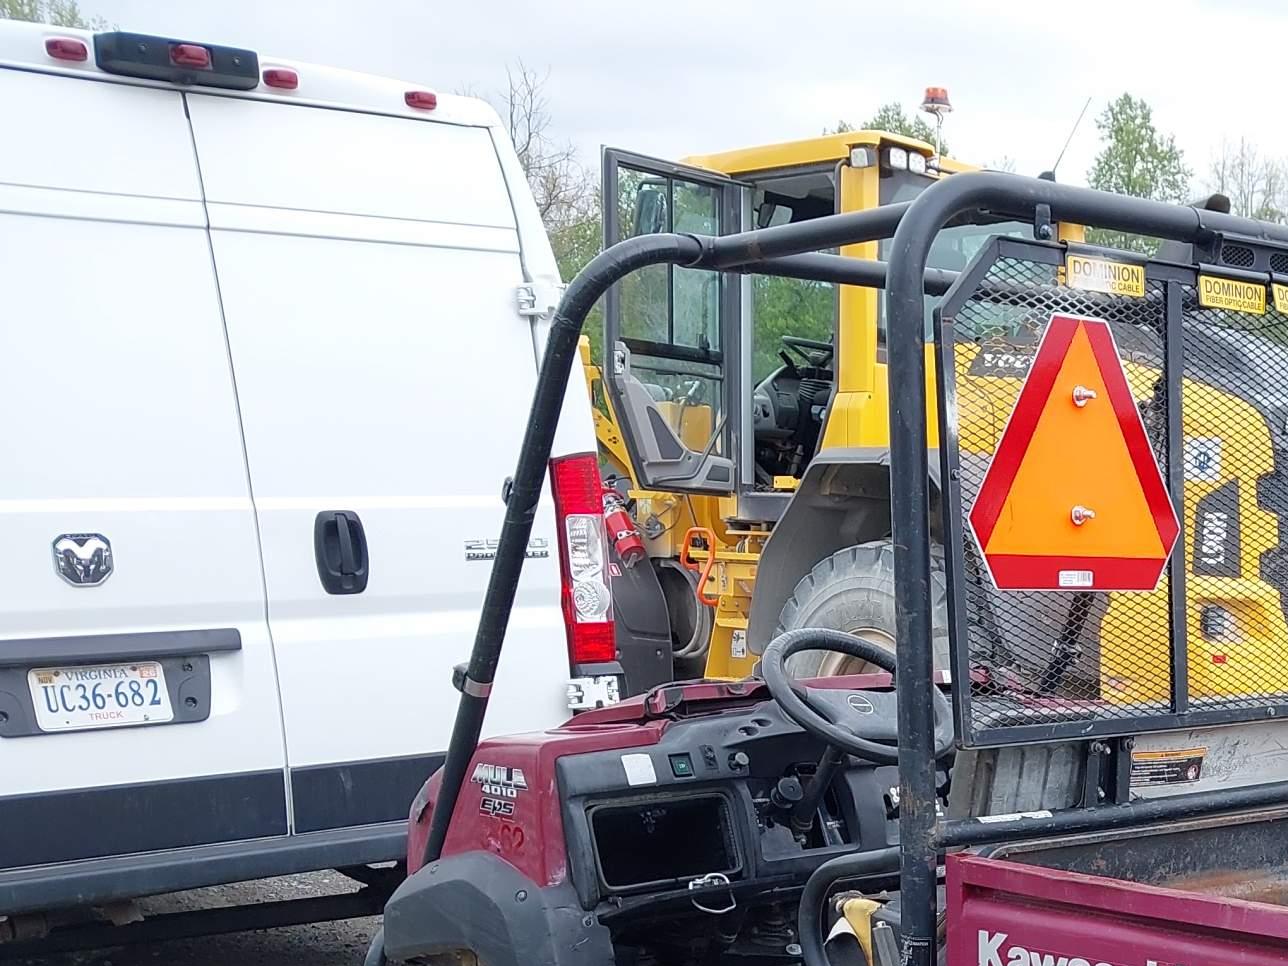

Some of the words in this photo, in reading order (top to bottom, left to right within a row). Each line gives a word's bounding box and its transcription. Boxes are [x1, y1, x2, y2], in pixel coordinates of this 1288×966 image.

[1117, 283, 1140, 293] CABLE
[1205, 280, 1262, 302] DOMINION
[463, 538, 549, 550] 250
[64, 668, 128, 681] VIRGINIA
[41, 679, 161, 713] UC36-682
[89, 710, 124, 721] TRUCK
[471, 763, 528, 790] MULE
[481, 784, 517, 798] 4010
